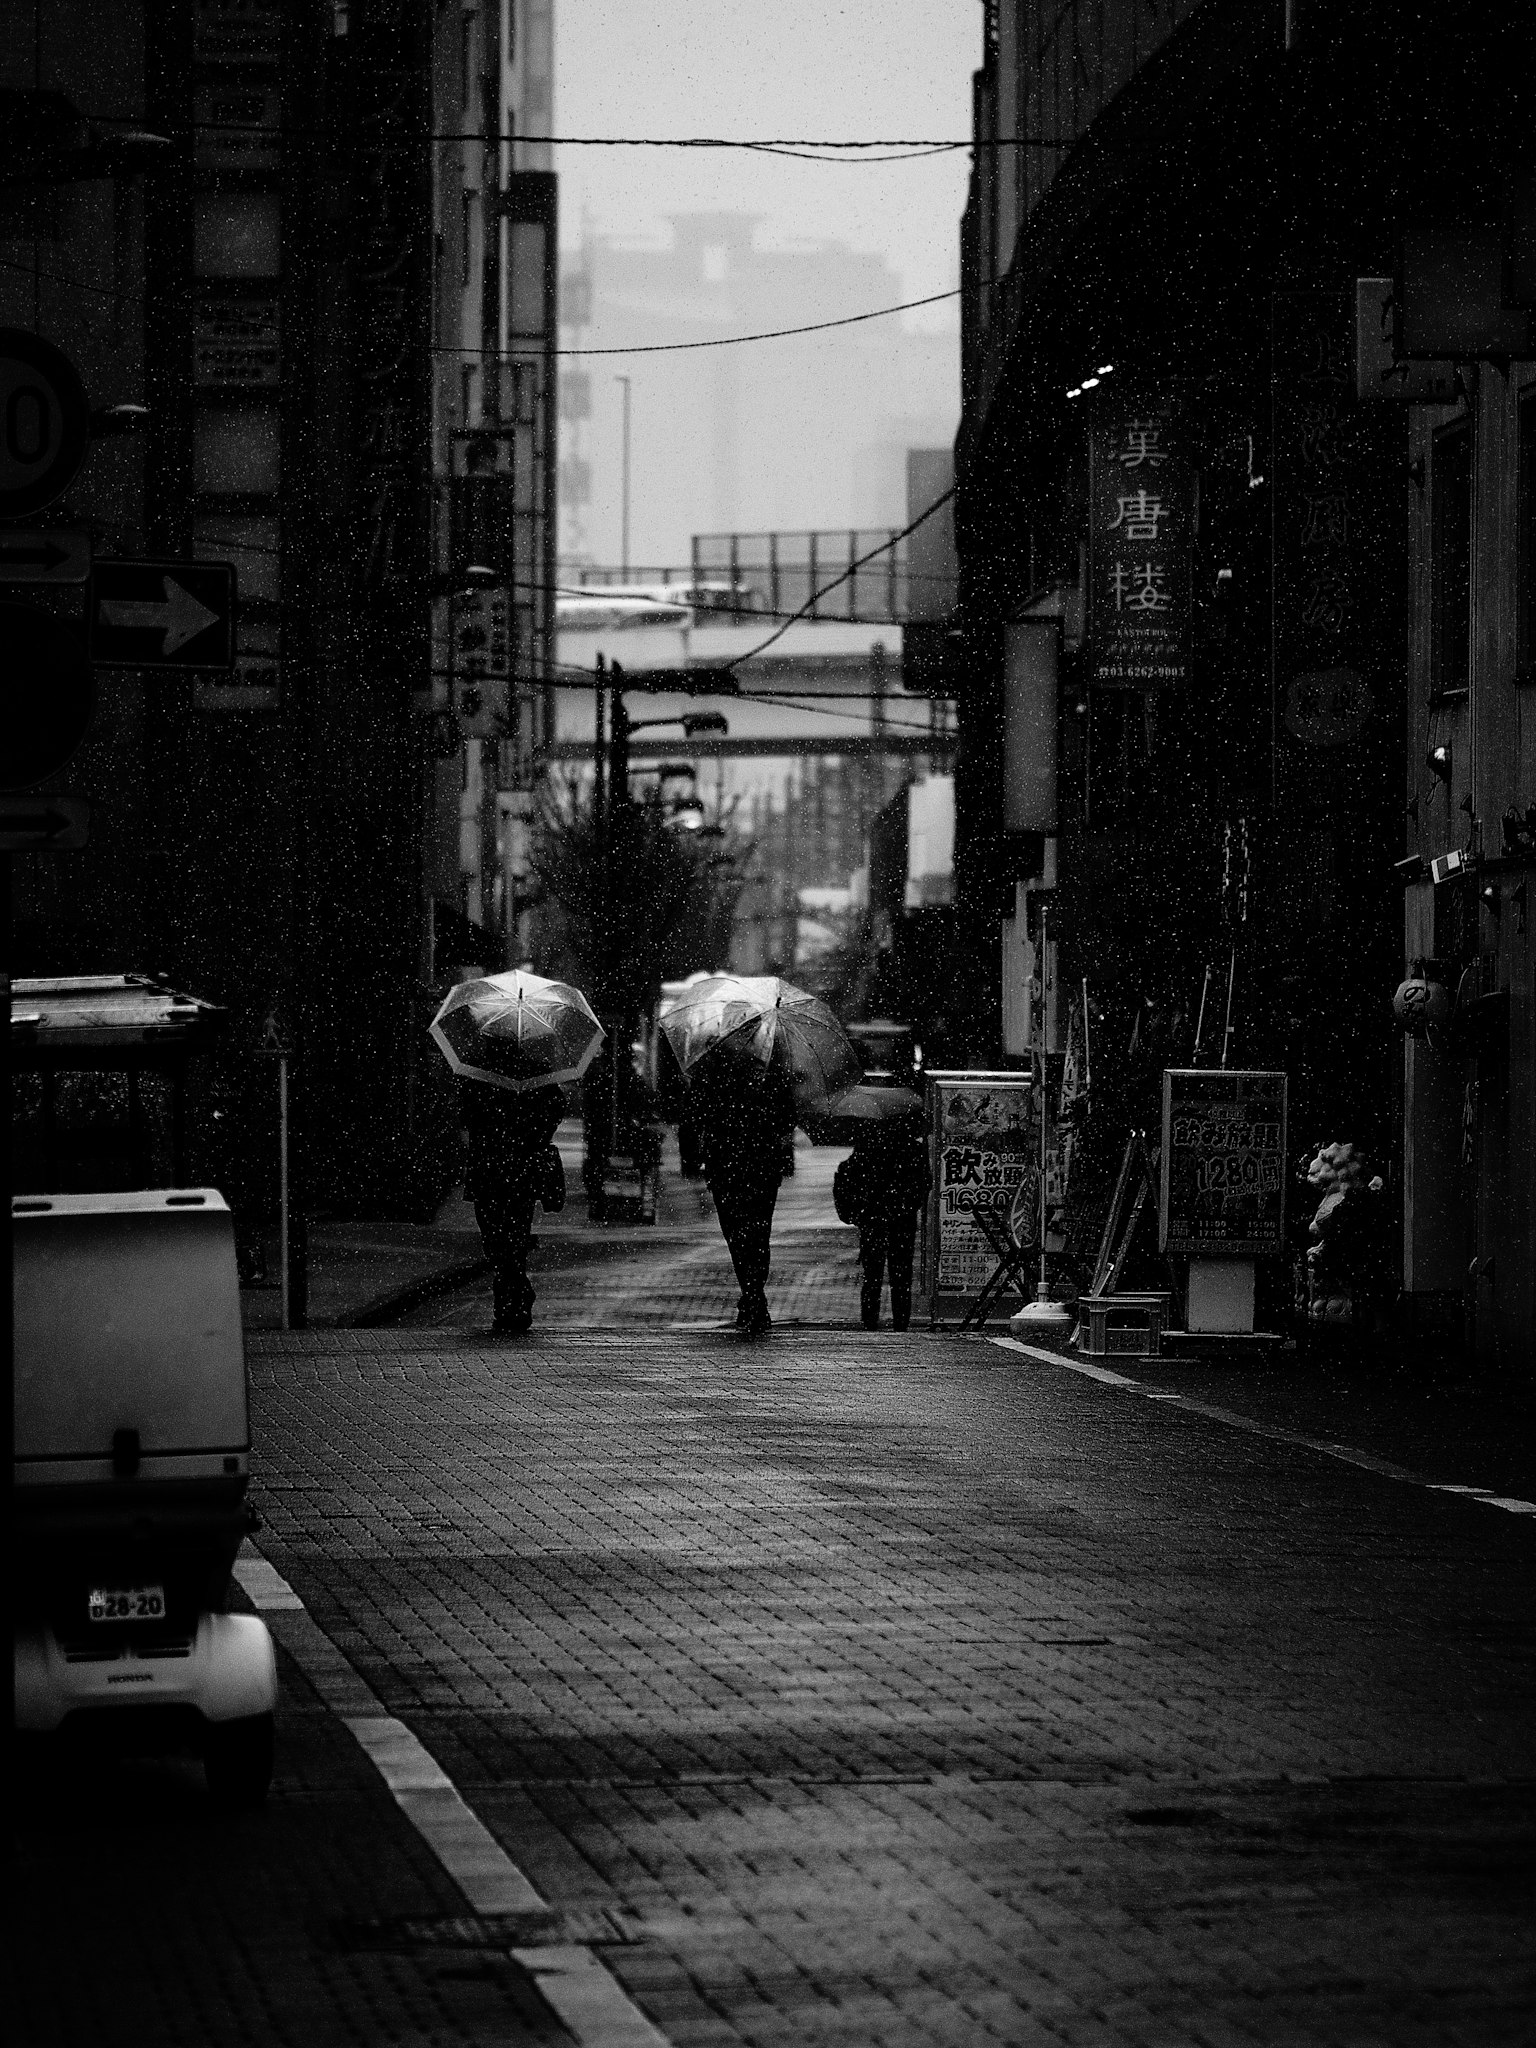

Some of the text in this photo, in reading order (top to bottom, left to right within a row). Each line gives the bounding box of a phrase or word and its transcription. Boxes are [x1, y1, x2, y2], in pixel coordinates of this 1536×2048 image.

[1105, 418, 1172, 611] 漢唐楼
[1174, 1119, 1279, 1150] 飲み放題
[1199, 1220, 1227, 1228] 11:00
[1199, 1229, 1227, 1237] 17:00
[105, 1595, 162, 1617] 28-20
